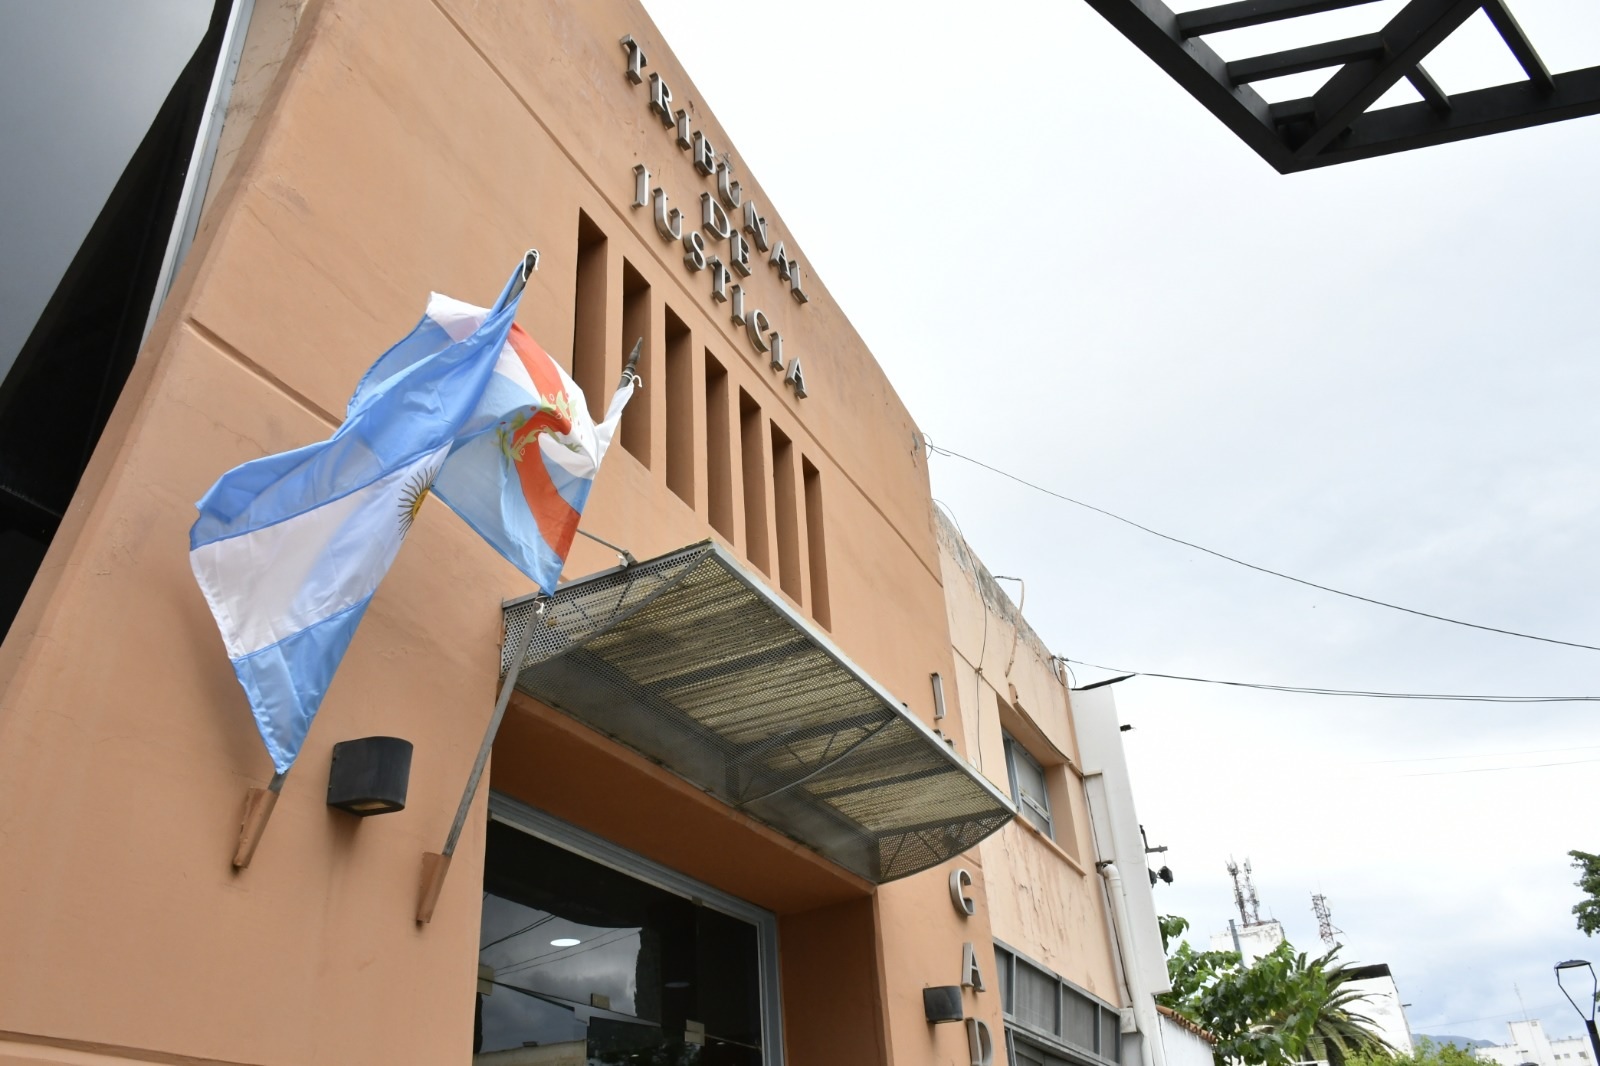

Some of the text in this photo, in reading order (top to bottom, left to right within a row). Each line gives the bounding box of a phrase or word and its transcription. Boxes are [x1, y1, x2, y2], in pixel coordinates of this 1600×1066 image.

[620, 33, 808, 303] TRIBUNAL
[631, 163, 808, 399] JUSTICIA
[700, 191, 752, 277] DE
